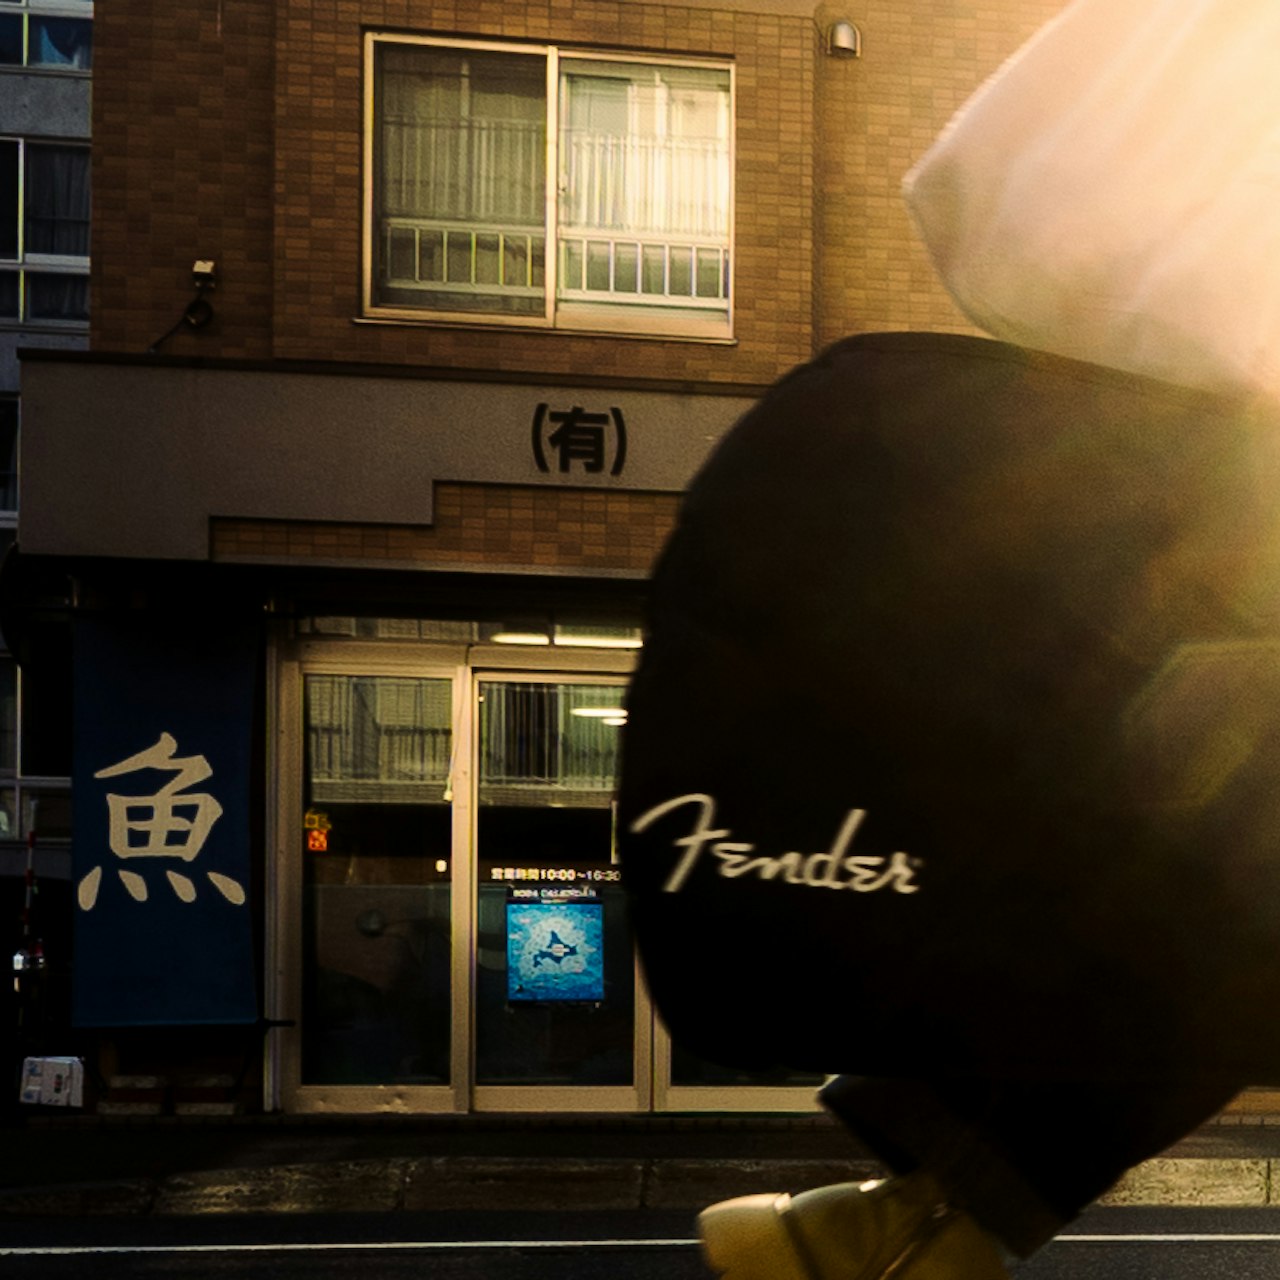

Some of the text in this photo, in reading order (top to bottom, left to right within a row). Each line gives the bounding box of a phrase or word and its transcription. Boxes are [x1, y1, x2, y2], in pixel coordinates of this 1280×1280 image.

[532, 402, 627, 477] (有)
[78, 731, 246, 912] 魚
[629, 793, 920, 893] Fender
